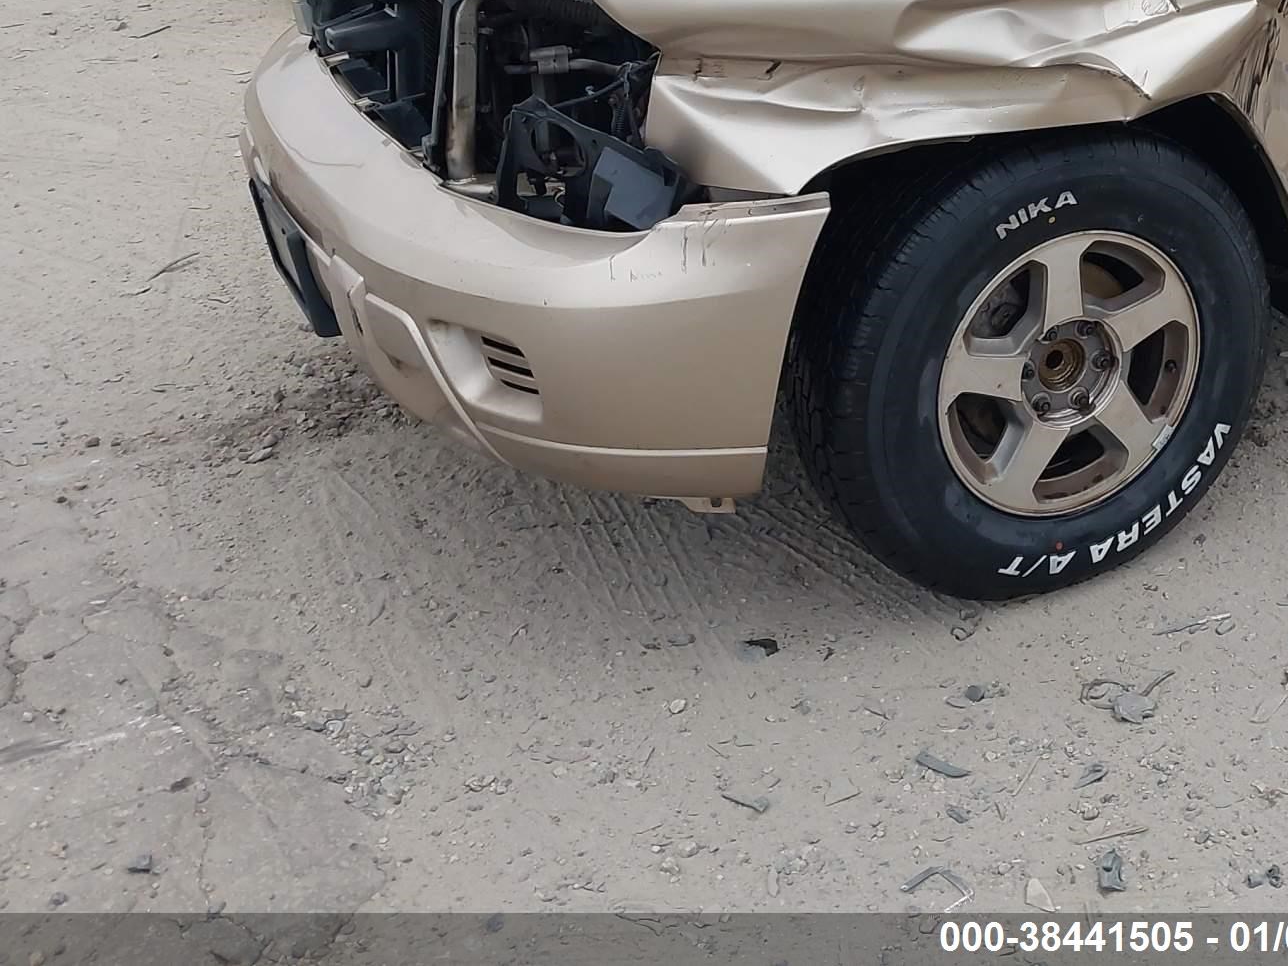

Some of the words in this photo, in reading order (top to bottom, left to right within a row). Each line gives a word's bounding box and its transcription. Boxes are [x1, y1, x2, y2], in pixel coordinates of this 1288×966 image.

[995, 190, 1079, 240] NIKA
[1088, 422, 1232, 564] VASTERA
[997, 550, 1077, 578] A/T
